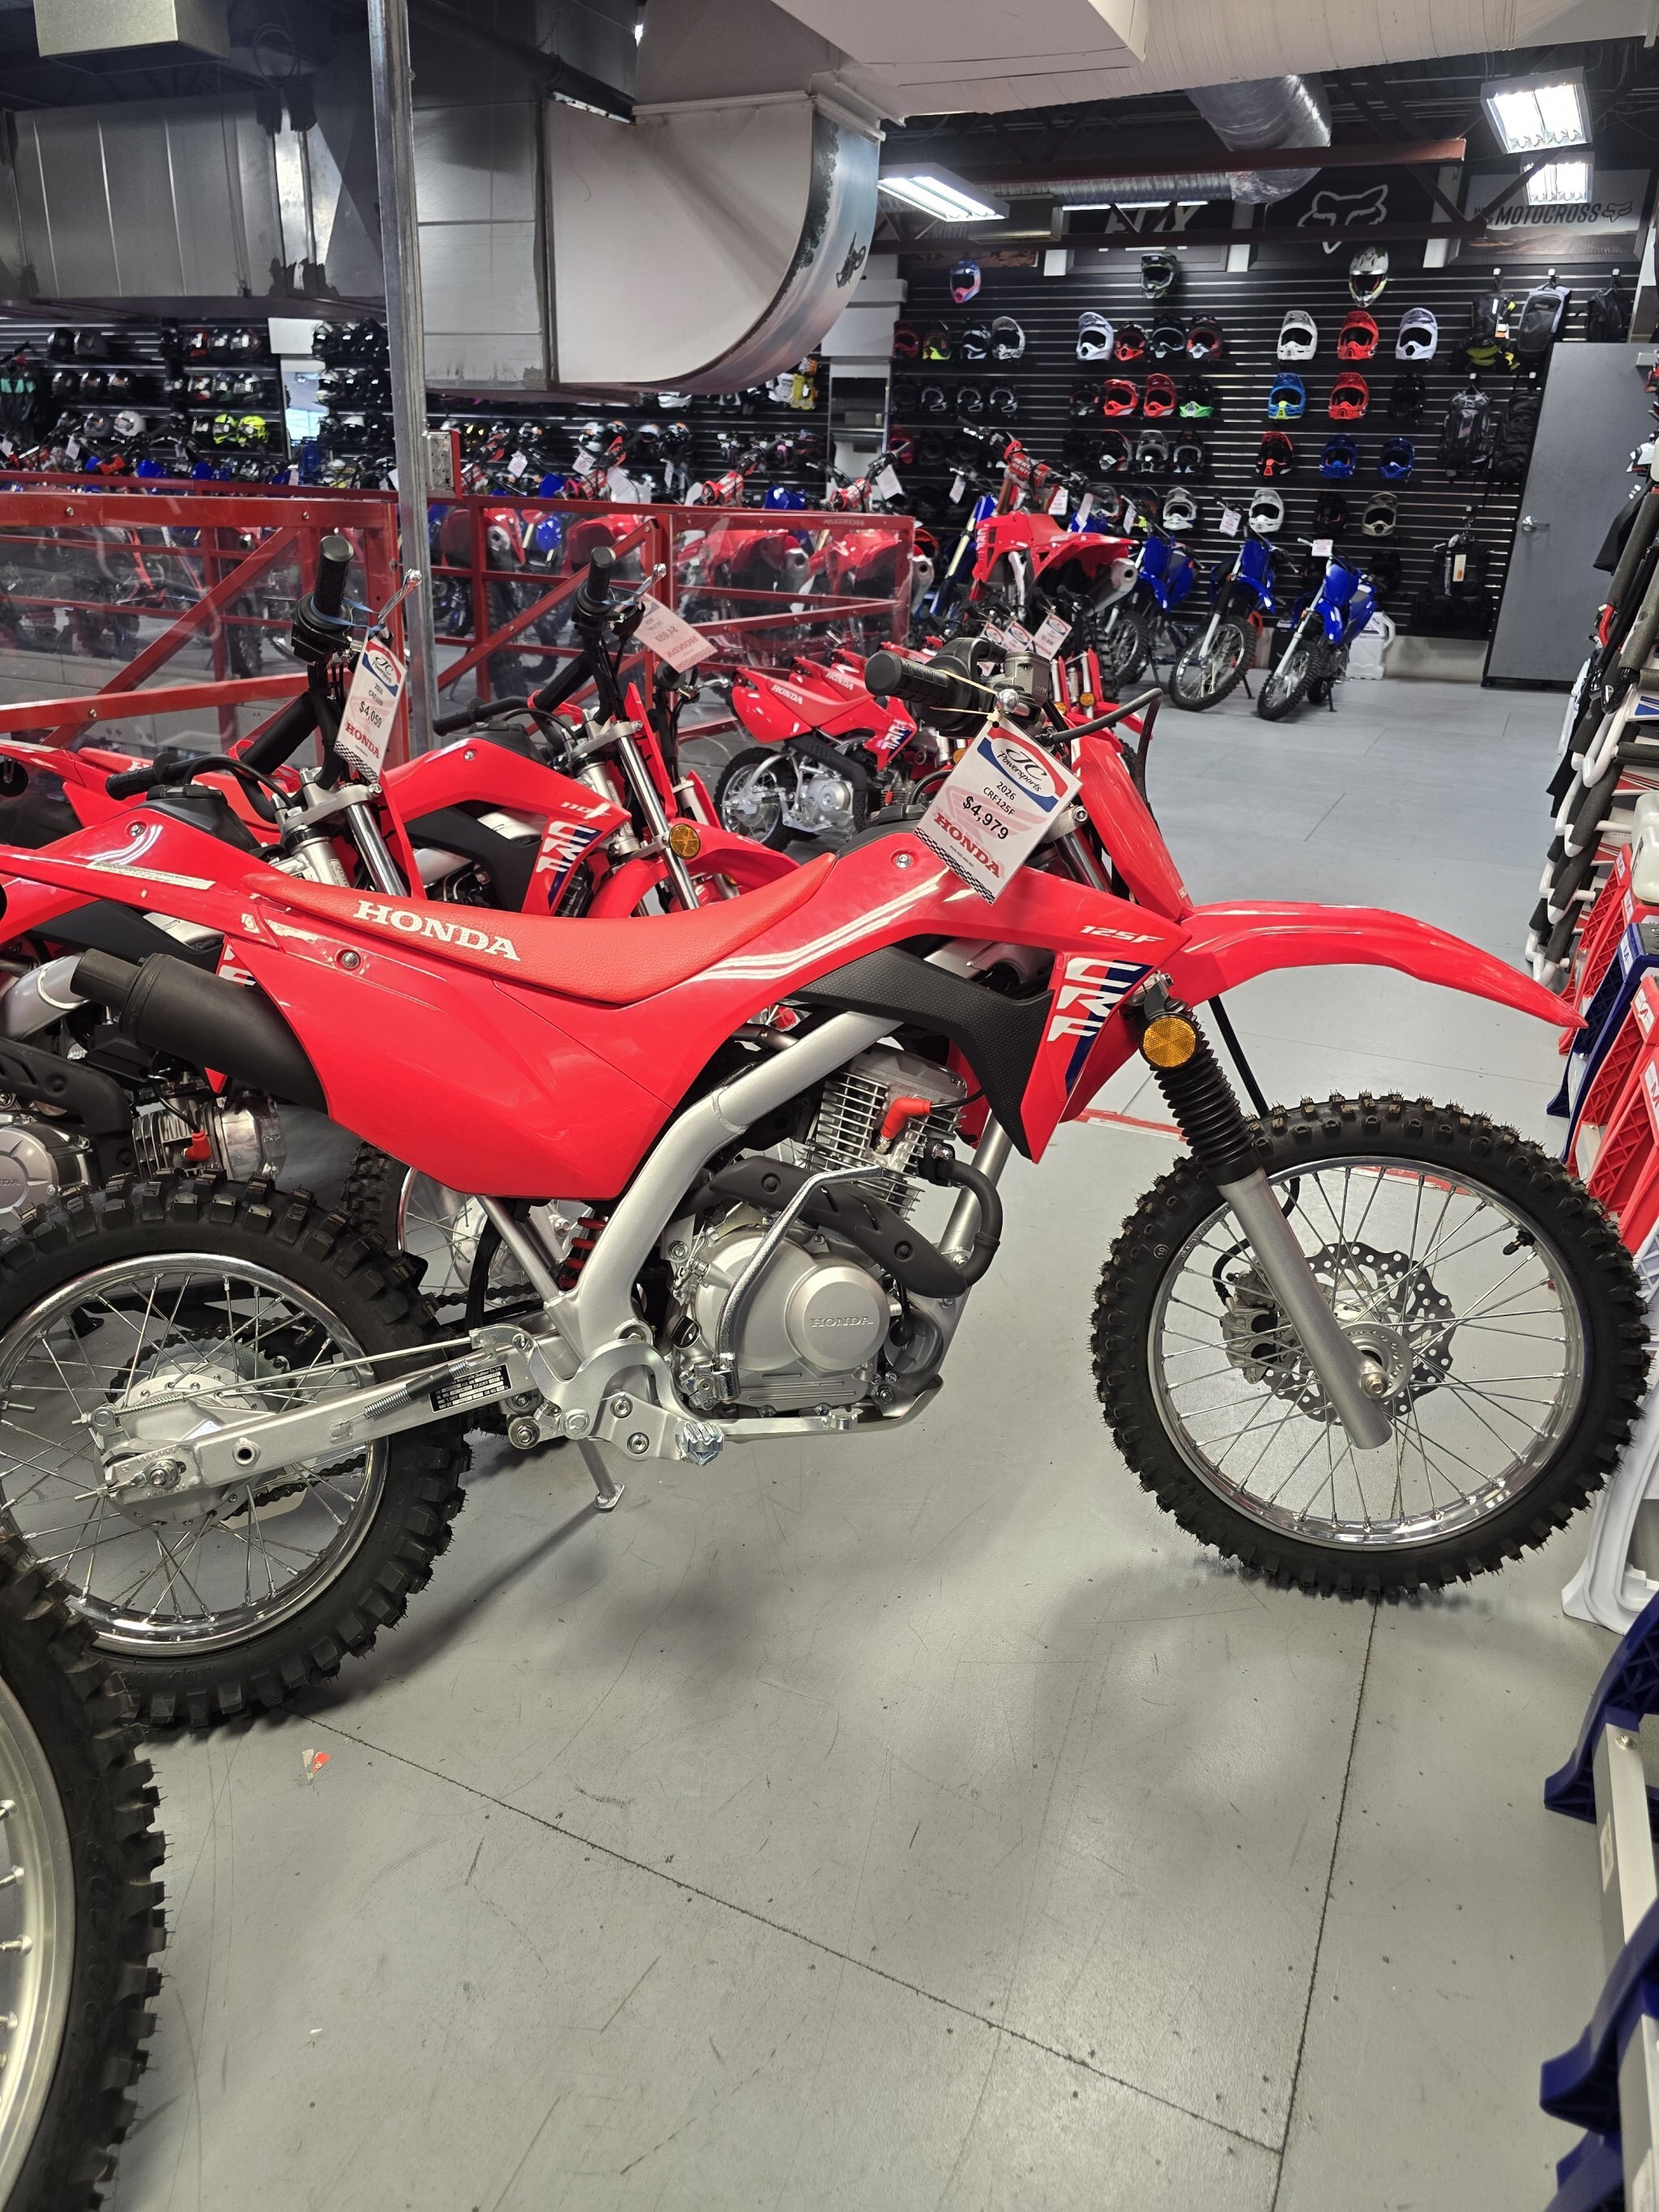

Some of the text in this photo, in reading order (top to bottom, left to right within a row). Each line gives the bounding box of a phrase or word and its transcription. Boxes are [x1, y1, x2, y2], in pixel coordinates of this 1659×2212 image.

[1495, 202, 1601, 225] MOTOCROSS
[372, 661, 393, 684] Powersports
[825, 671, 854, 690] HONDA
[771, 684, 803, 705] HONDA
[359, 701, 382, 728] $4,059
[345, 722, 380, 759] HONDA
[996, 750, 1042, 792] Powersports
[1005, 748, 1048, 782] JC
[983, 786, 1016, 816] CRF125F
[996, 781, 1017, 800] 2026
[962, 795, 1009, 840] $4,979
[535, 820, 596, 873] CRF
[933, 812, 1000, 878] HONDA
[353, 900, 521, 961] HONDA
[1080, 925, 1166, 944] 125F
[1047, 957, 1143, 1042] CRF
[810, 1316, 874, 1328] HONDA
